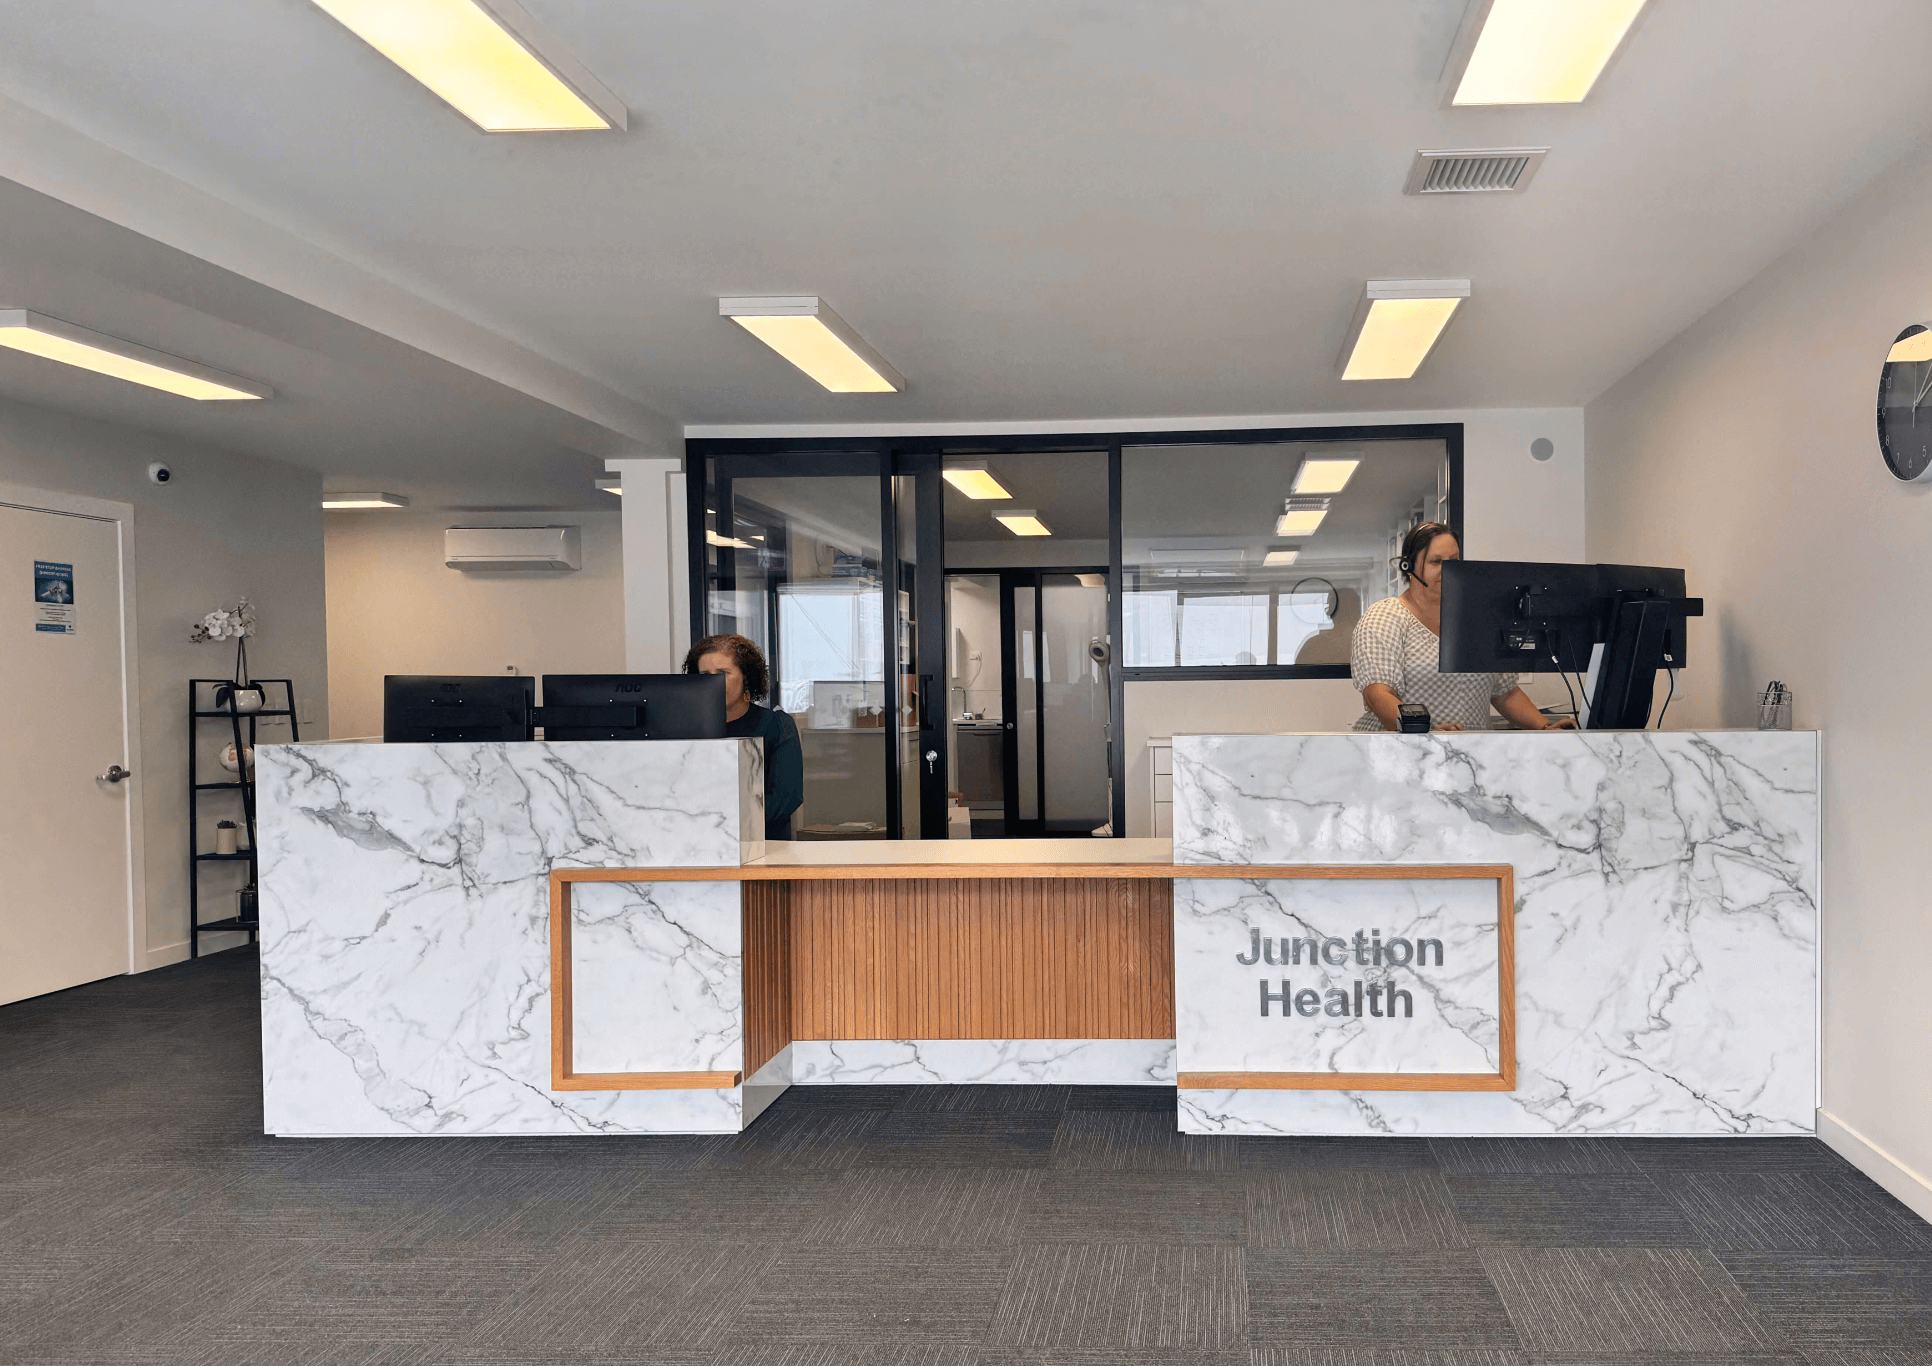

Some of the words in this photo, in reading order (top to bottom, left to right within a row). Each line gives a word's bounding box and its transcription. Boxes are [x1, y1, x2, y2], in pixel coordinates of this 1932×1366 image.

[1885, 376, 1892, 389] 10
[1881, 407, 1887, 419] 9
[1885, 434, 1890, 446] 8
[1922, 445, 1927, 458] 5
[1896, 452, 1900, 464] 7
[1908, 457, 1913, 468] 6
[1236, 927, 1444, 967] Junction
[1259, 979, 1414, 1018] Health
